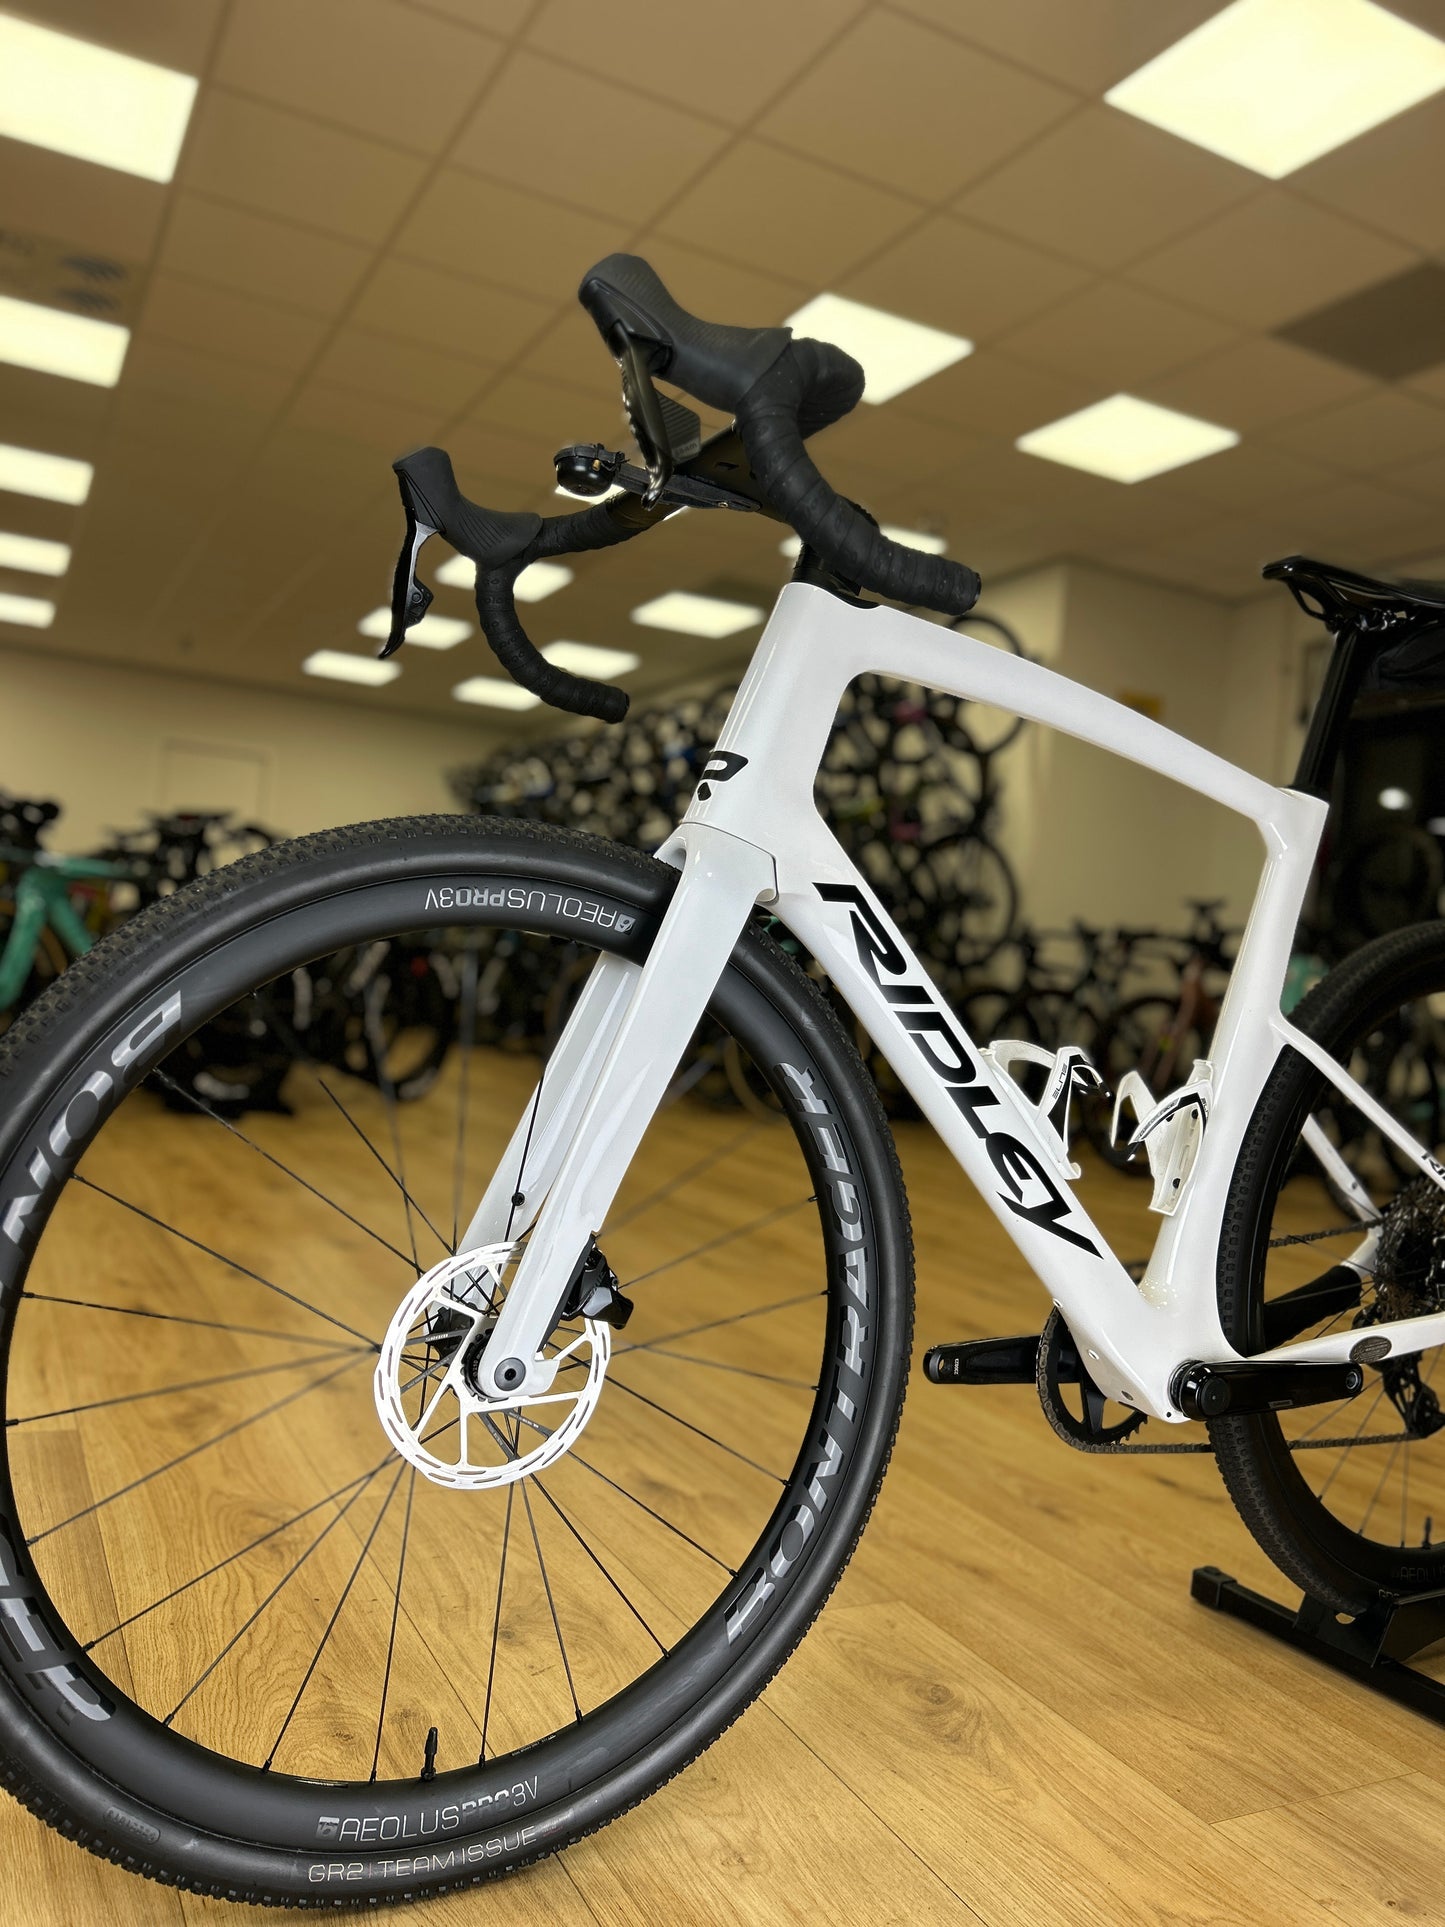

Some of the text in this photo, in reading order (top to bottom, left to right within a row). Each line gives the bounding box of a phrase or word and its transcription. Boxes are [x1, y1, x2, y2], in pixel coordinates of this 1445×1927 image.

[812, 882, 1104, 1259] RIDLEY
[1421, 1152, 1445, 1182] RI
[723, 1062, 870, 1647] BONTRAGER
[308, 1825, 537, 1883] GR2 TEAM ISSUE
